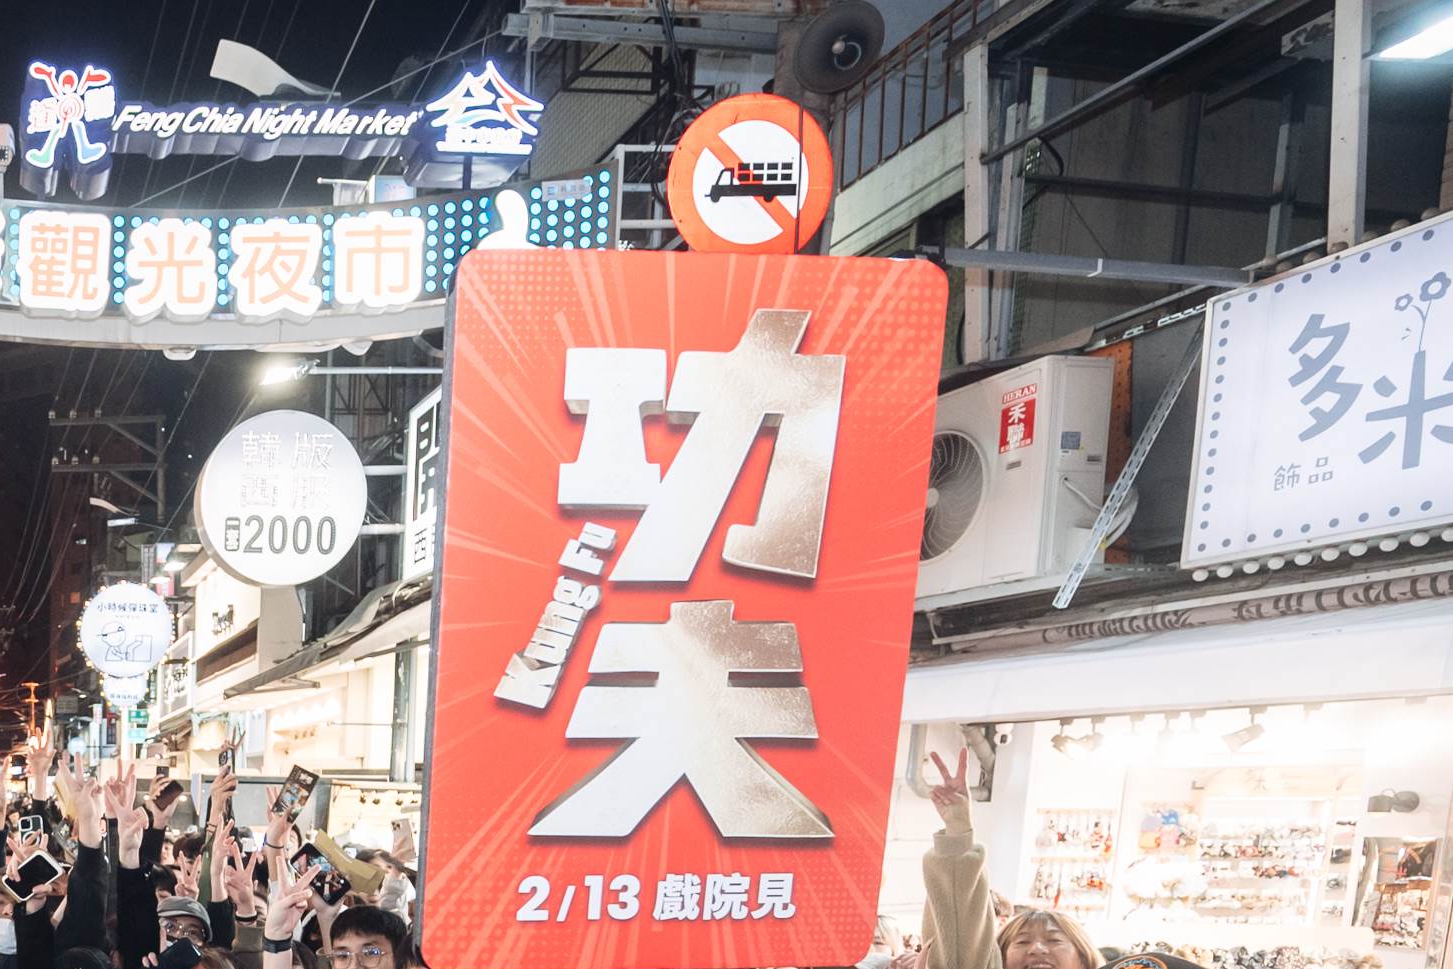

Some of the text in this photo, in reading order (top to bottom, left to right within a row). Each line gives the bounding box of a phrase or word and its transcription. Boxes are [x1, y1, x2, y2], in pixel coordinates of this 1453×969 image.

[113, 105, 185, 138] Feng
[182, 103, 243, 134] Chia
[241, 104, 317, 140] Night
[313, 107, 418, 136] Market
[1274, 456, 1334, 491] 飾品
[243, 514, 336, 555] 2000
[515, 872, 796, 922] 2/13 戲院見
